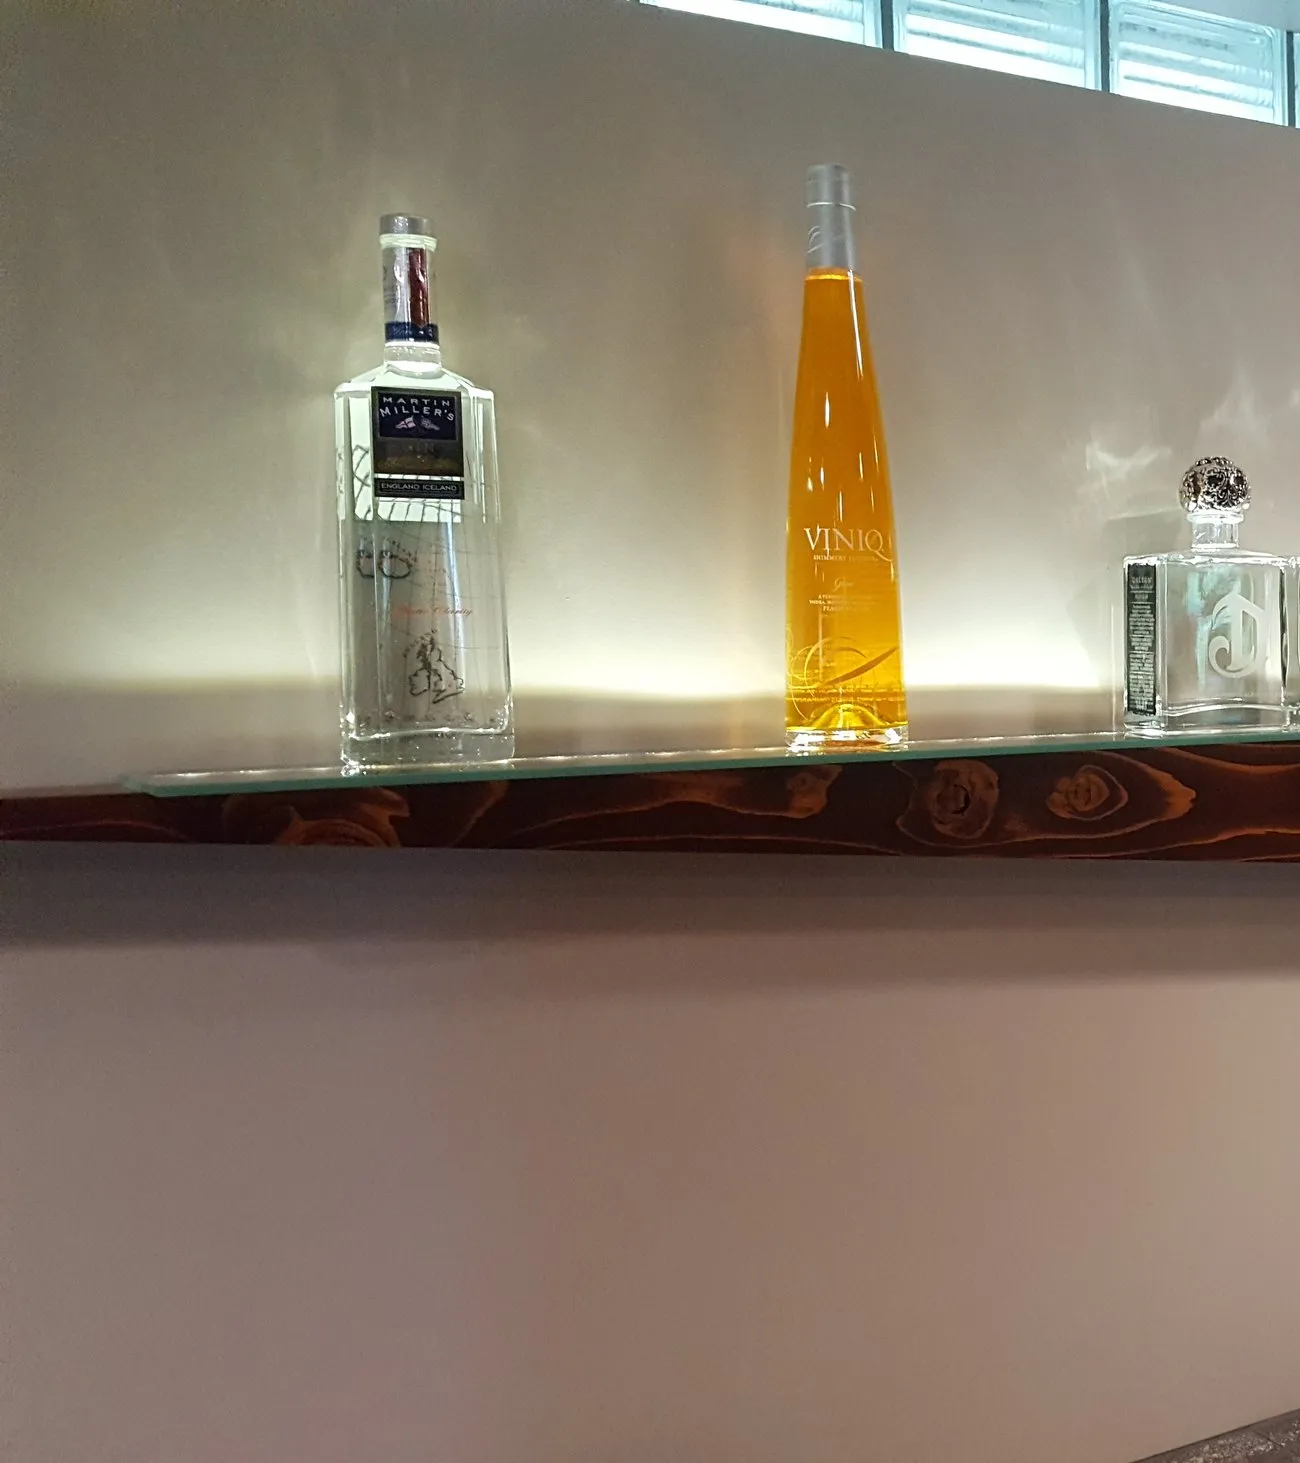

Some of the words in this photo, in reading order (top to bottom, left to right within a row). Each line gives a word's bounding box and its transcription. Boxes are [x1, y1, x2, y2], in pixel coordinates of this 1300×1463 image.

[383, 397, 450, 407] MARTIN
[380, 406, 455, 422] MILLER'S
[422, 484, 457, 492] ICELAND
[803, 527, 893, 562] VINIQ
